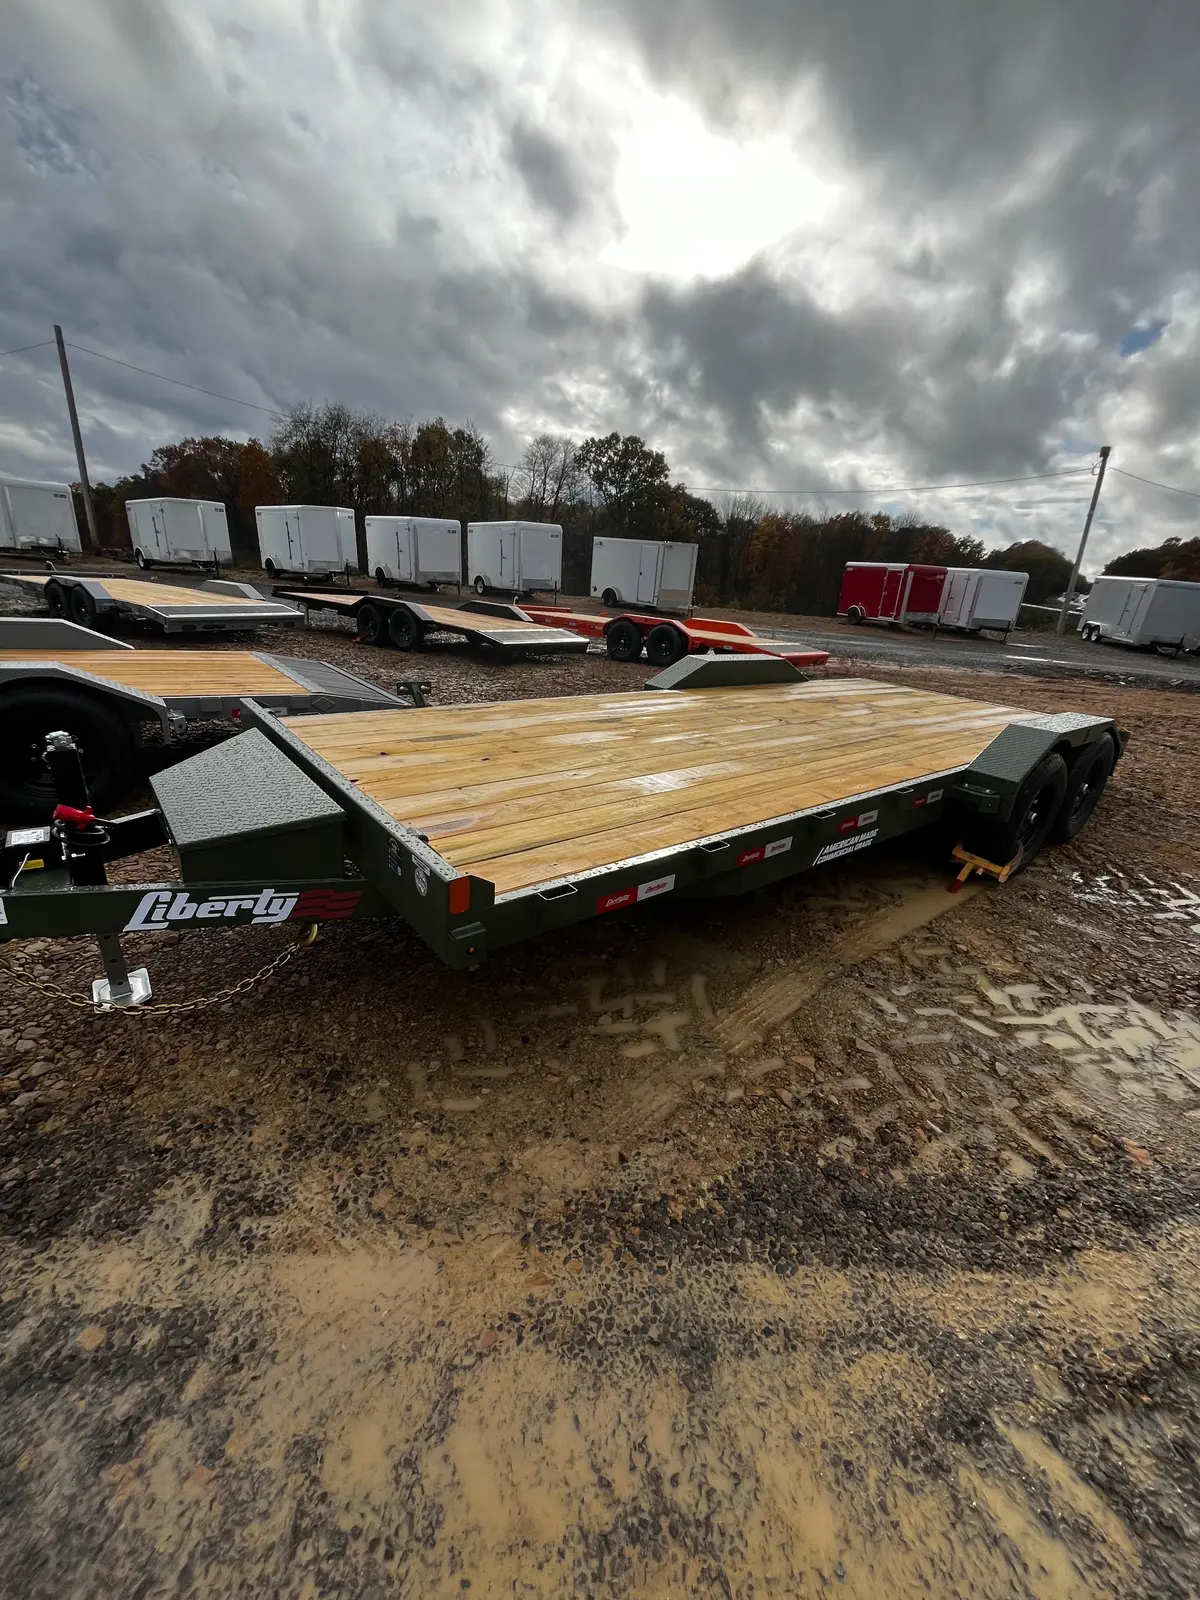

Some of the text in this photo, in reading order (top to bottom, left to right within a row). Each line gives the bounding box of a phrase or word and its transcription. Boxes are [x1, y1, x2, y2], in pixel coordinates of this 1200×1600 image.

[816, 838, 873, 864] COMMERCIAL GRADE
[822, 828, 879, 855] AMERICAN MADE
[122, 888, 300, 932] Liberty
